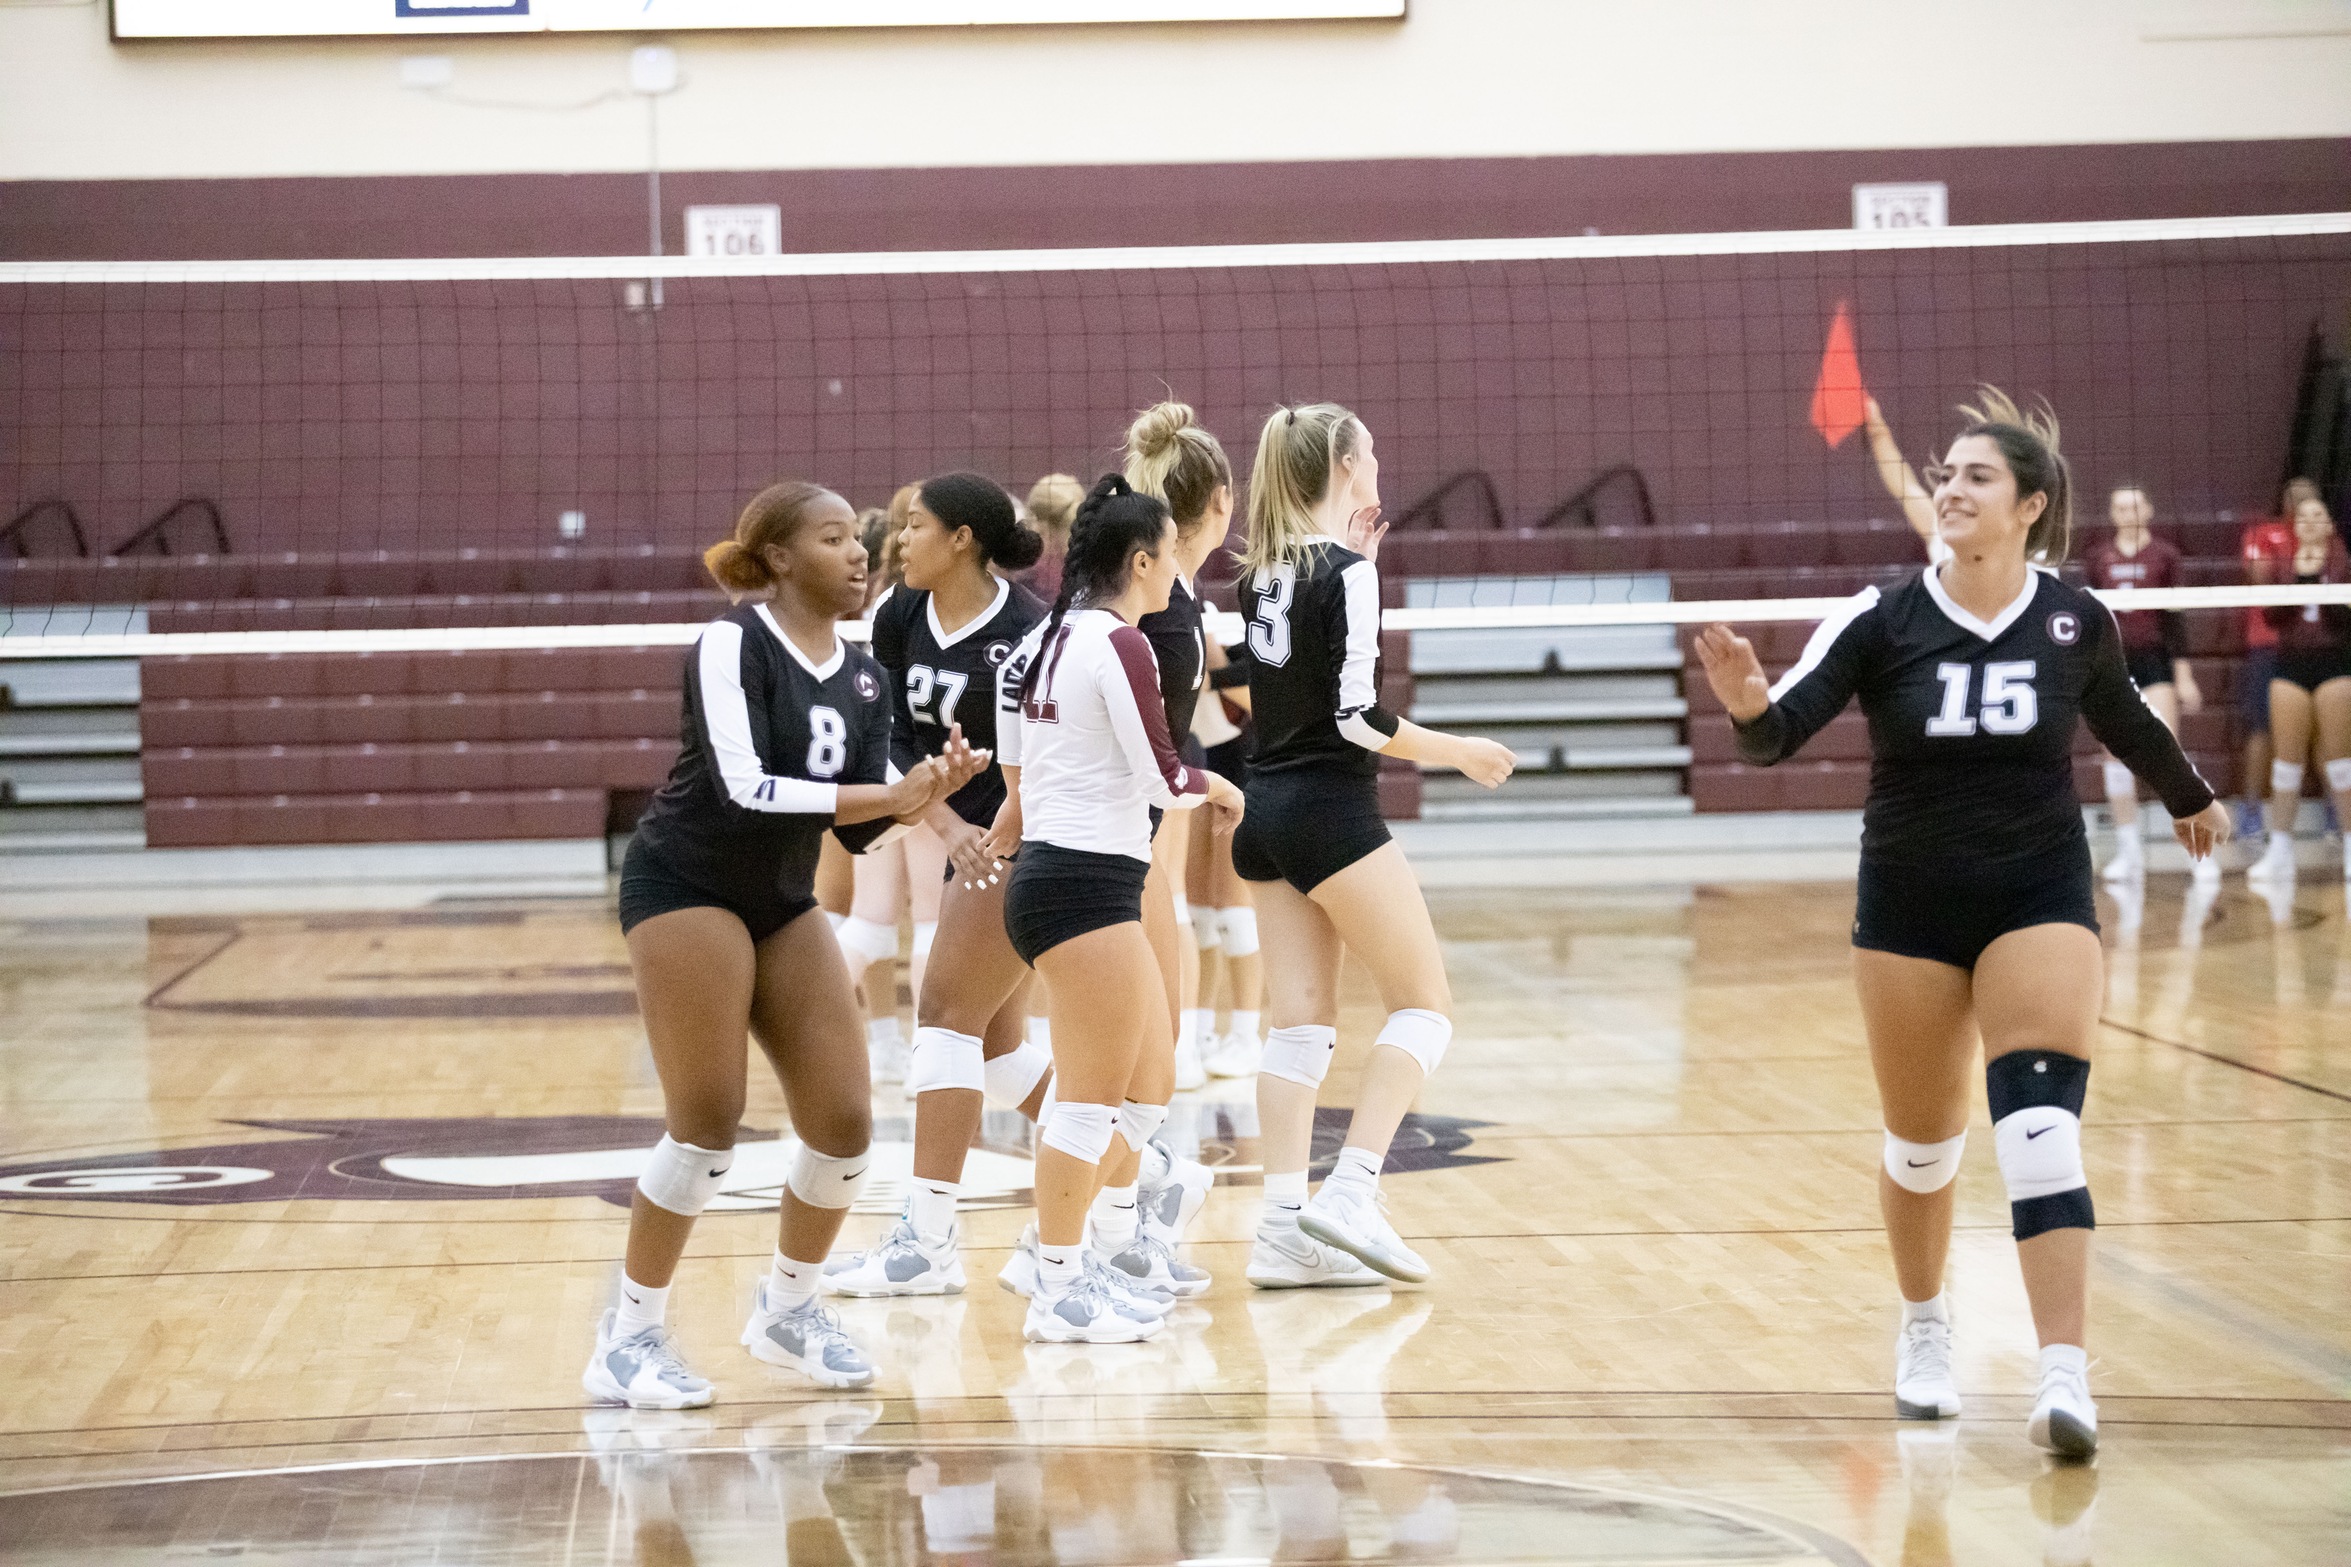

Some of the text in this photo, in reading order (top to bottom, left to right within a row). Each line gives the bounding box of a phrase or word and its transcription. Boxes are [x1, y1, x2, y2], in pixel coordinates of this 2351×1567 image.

[705, 232, 765, 256] 106
[1249, 558, 1296, 668] 3
[2052, 615, 2076, 641] C
[906, 663, 969, 730] 27
[1924, 659, 2039, 738] 15
[806, 704, 847, 779] 8
